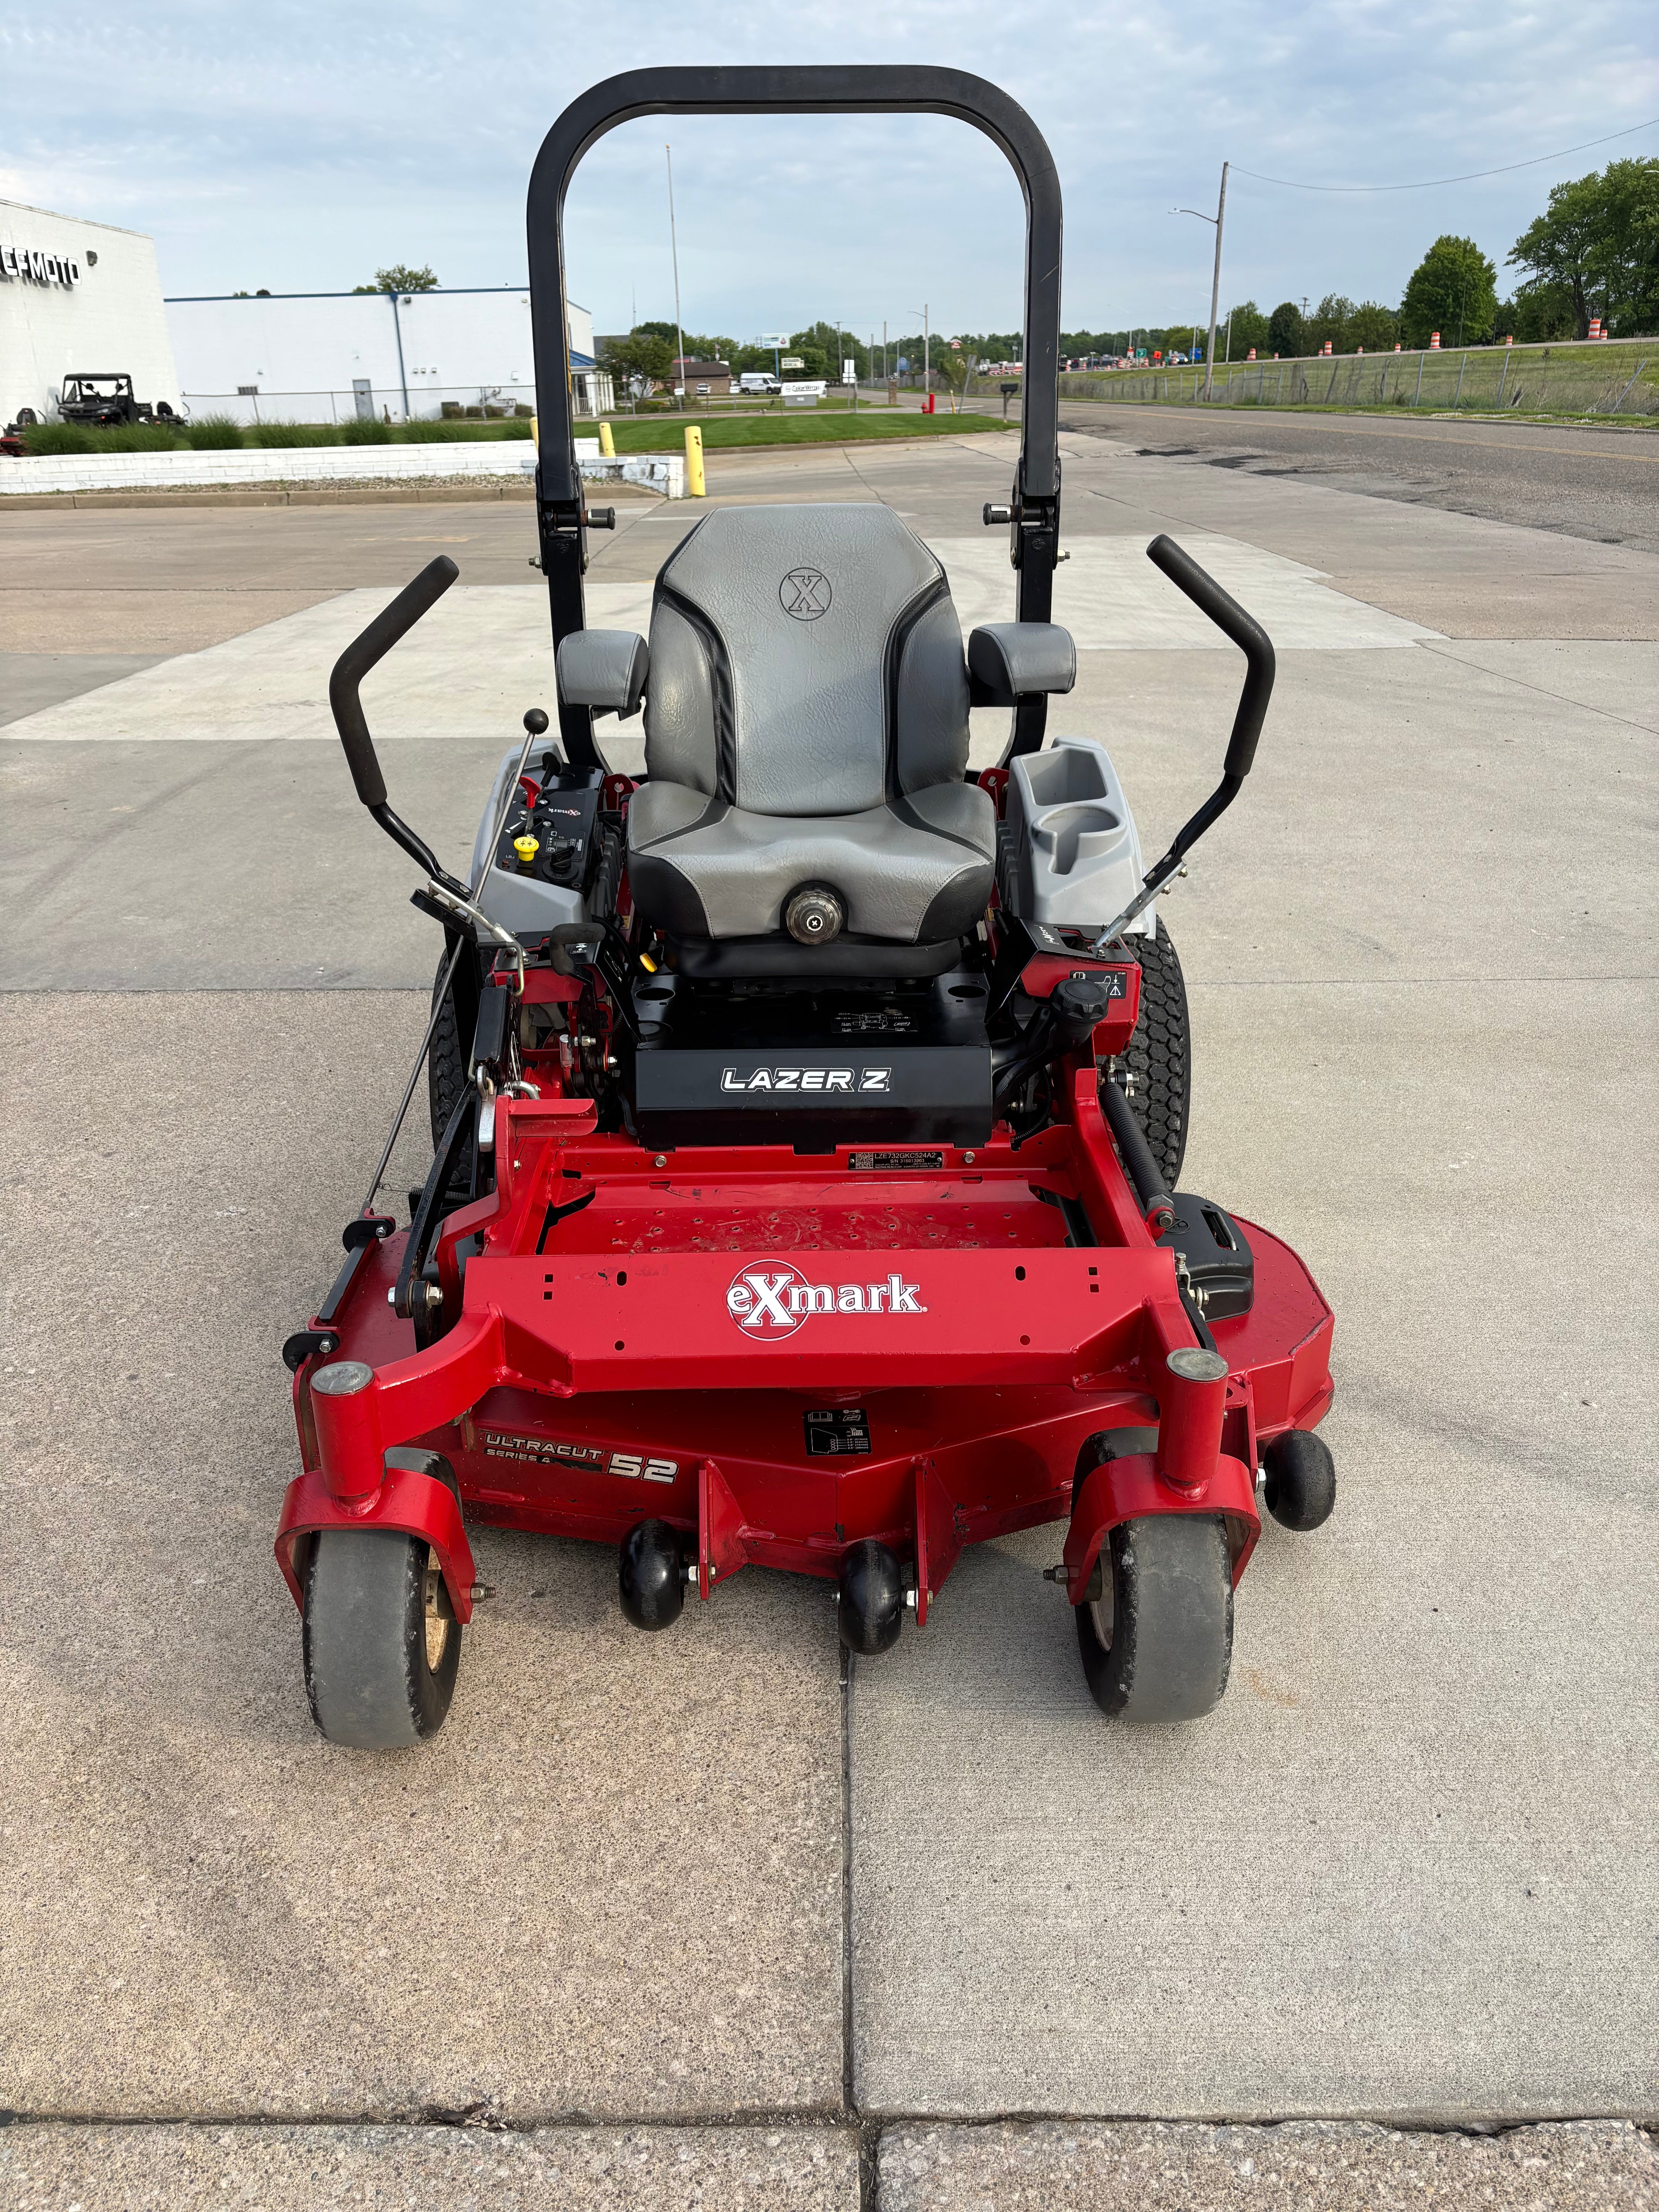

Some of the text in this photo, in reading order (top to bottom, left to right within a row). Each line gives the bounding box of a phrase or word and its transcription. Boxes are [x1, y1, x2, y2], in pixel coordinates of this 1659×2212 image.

[1, 245, 81, 285] CFMOTO
[548, 808, 581, 816] eXmark
[721, 1067, 892, 1092] LAZER Z
[726, 1273, 922, 1326] eXmark
[486, 1448, 538, 1462] SERIES
[486, 1432, 679, 1485] ULTRACUT 52
